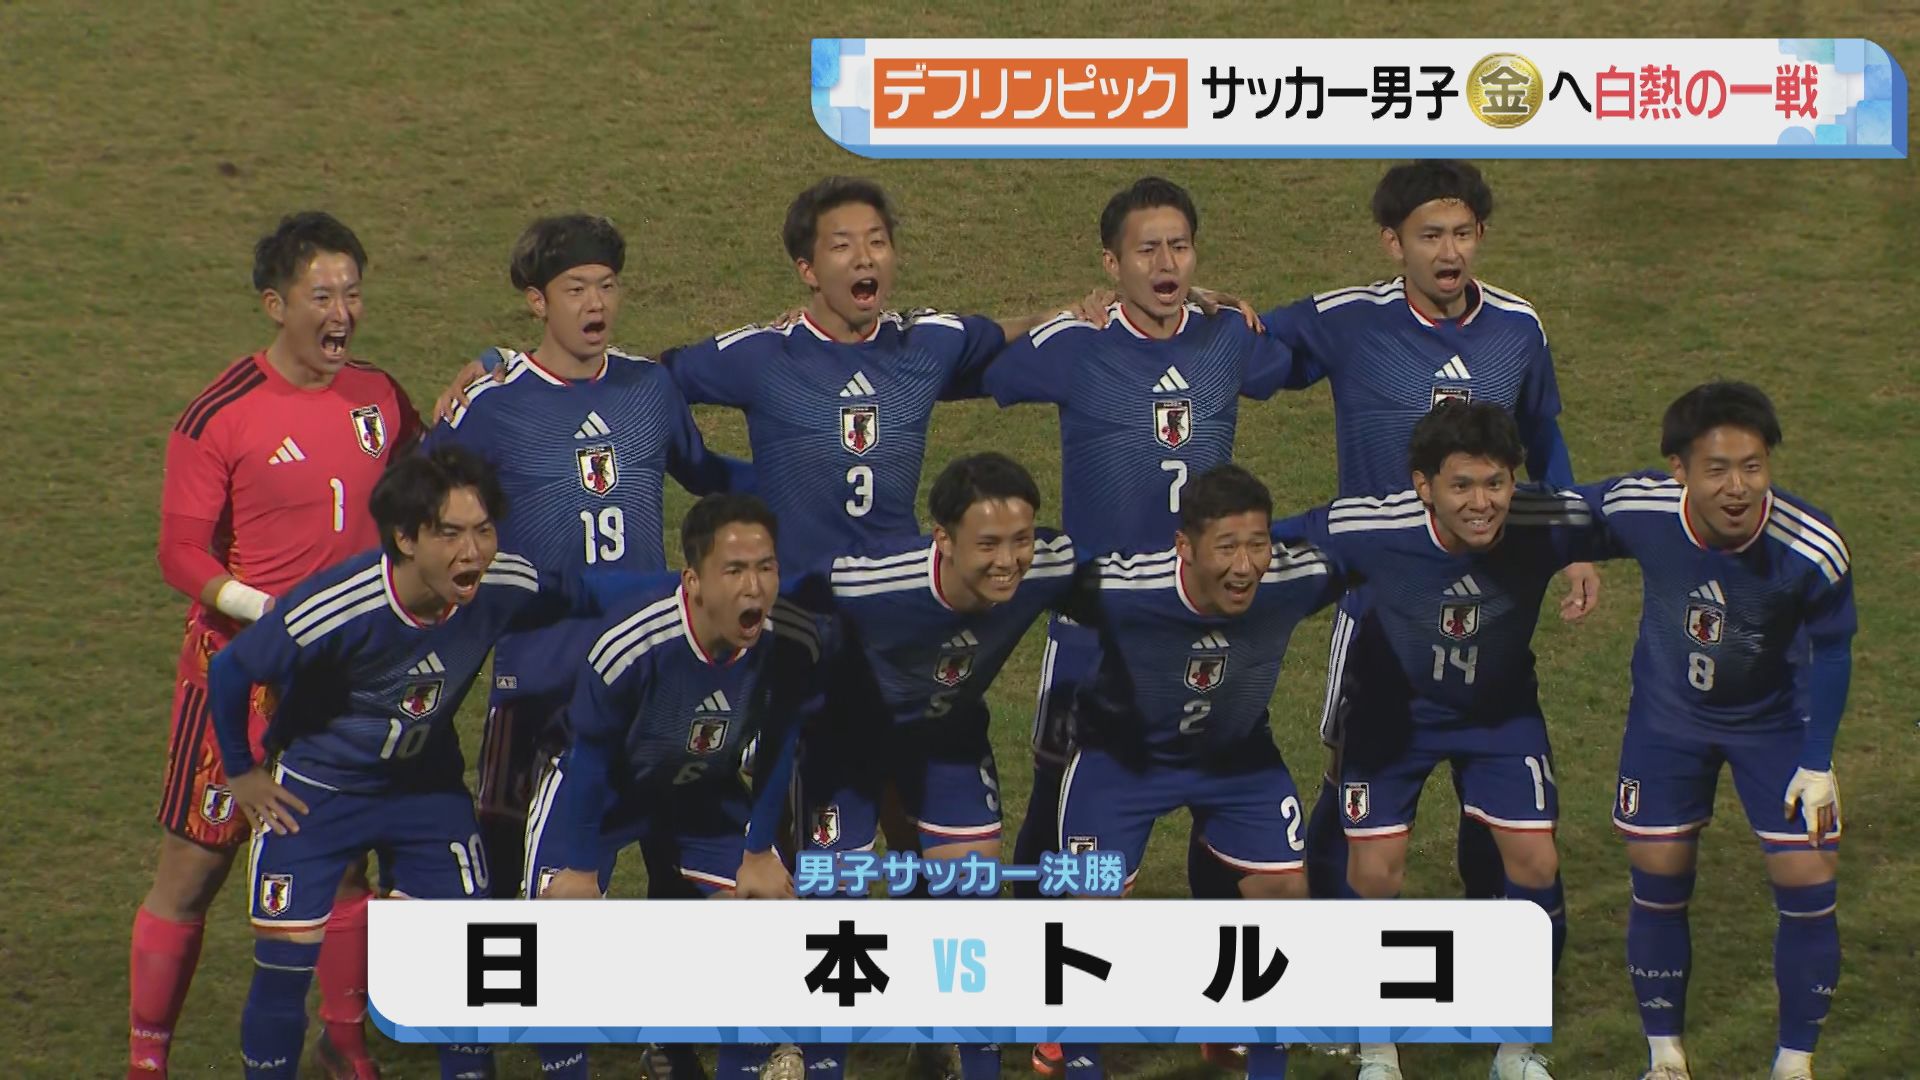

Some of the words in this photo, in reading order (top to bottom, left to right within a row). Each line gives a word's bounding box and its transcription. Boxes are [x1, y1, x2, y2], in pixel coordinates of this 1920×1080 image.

[329, 478, 345, 532] 1
[846, 465, 874, 518] 3
[1160, 460, 1188, 513] 7
[580, 506, 625, 564] 19
[1431, 643, 1478, 684] 14
[1687, 652, 1715, 691] 8
[380, 718, 431, 759] 10
[1179, 700, 1211, 734] 2
[1280, 795, 1305, 851] 2
[450, 833, 489, 895] 10
